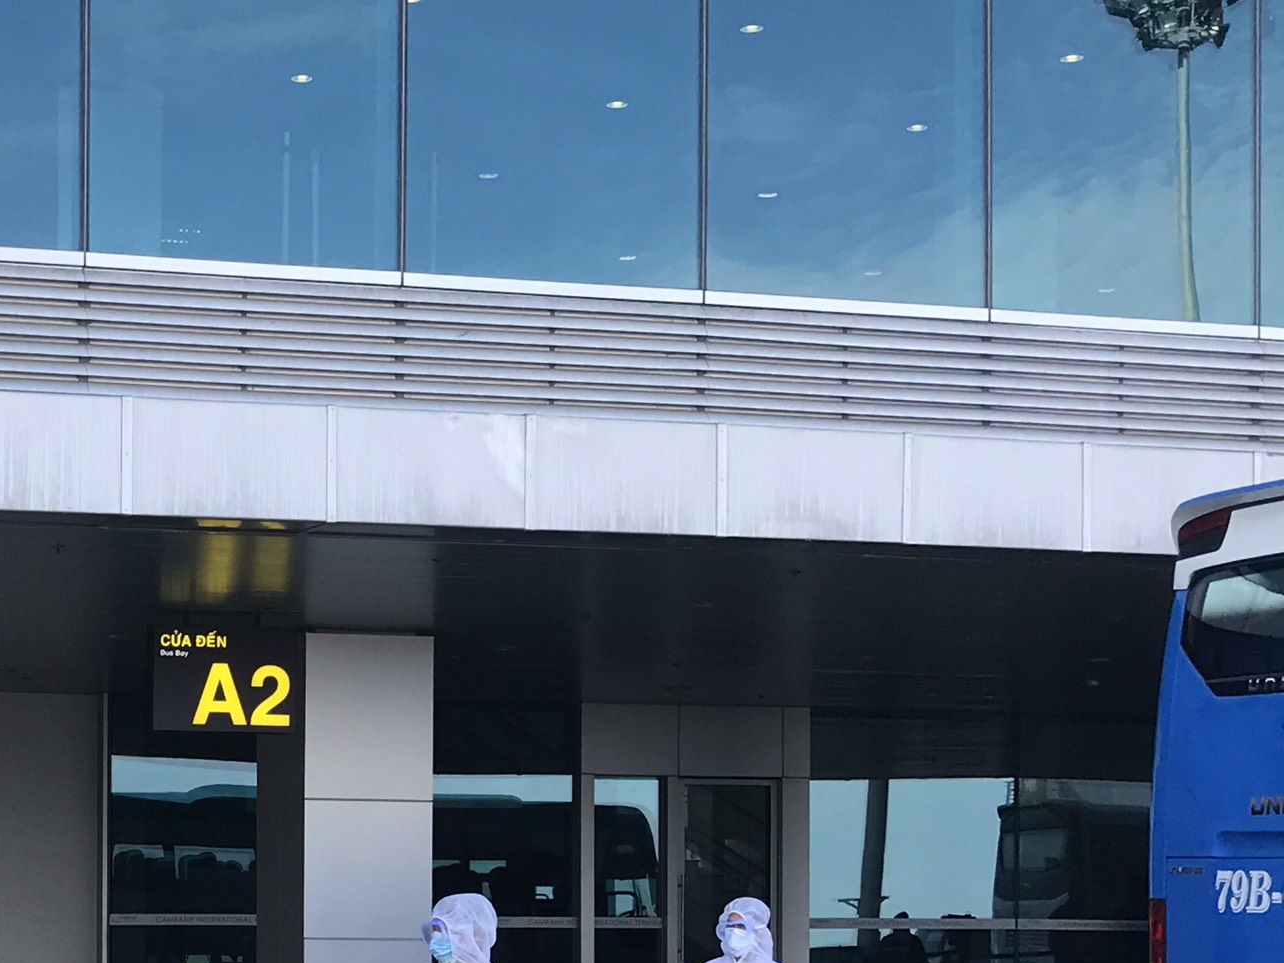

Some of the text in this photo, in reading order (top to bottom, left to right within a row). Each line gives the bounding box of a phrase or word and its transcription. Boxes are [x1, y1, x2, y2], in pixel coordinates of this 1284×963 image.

[160, 629, 227, 648] CỬA ĐẾN
[192, 663, 291, 727] A2
[1215, 869, 1284, 914] 79B-
